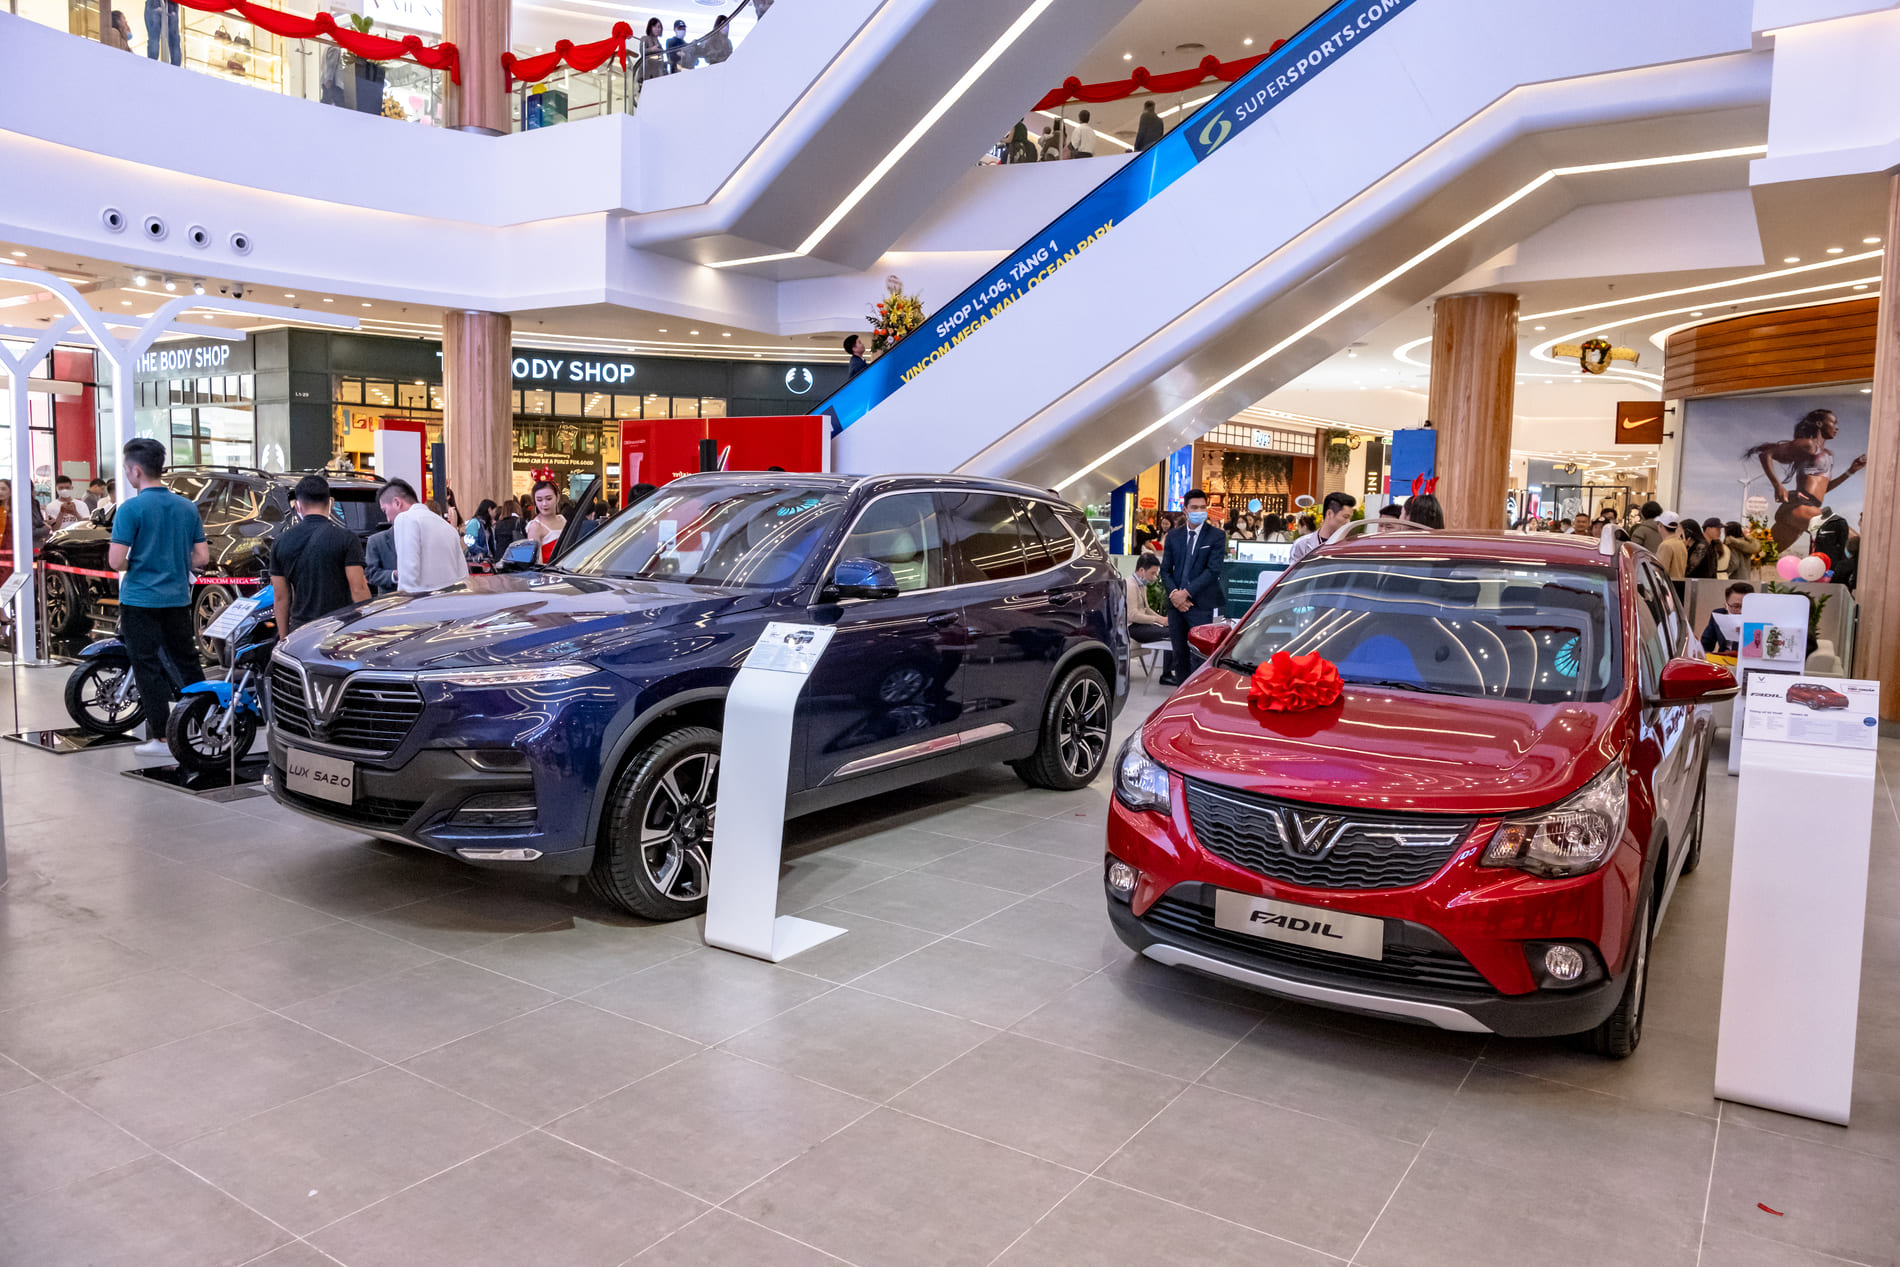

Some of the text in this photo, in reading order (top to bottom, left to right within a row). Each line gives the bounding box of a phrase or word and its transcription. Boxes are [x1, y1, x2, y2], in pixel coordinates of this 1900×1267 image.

[936, 304, 972, 338] SHOP
[973, 278, 1011, 312] L1-06,
[1049, 239, 1059, 252] 1
[900, 341, 952, 384] VINCOM
[951, 314, 990, 347] MEGA
[1027, 248, 1077, 290] OCEAN
[160, 348, 193, 371] BODY
[195, 344, 230, 368] SHOP
[511, 357, 635, 384] ODY SHOP
[1367, 471, 1378, 494] INI
[200, 577, 228, 585] VINCOM
[230, 577, 249, 585] MEGA
[289, 764, 350, 788] LUX SA2.0
[1250, 910, 1343, 939] FADIL
